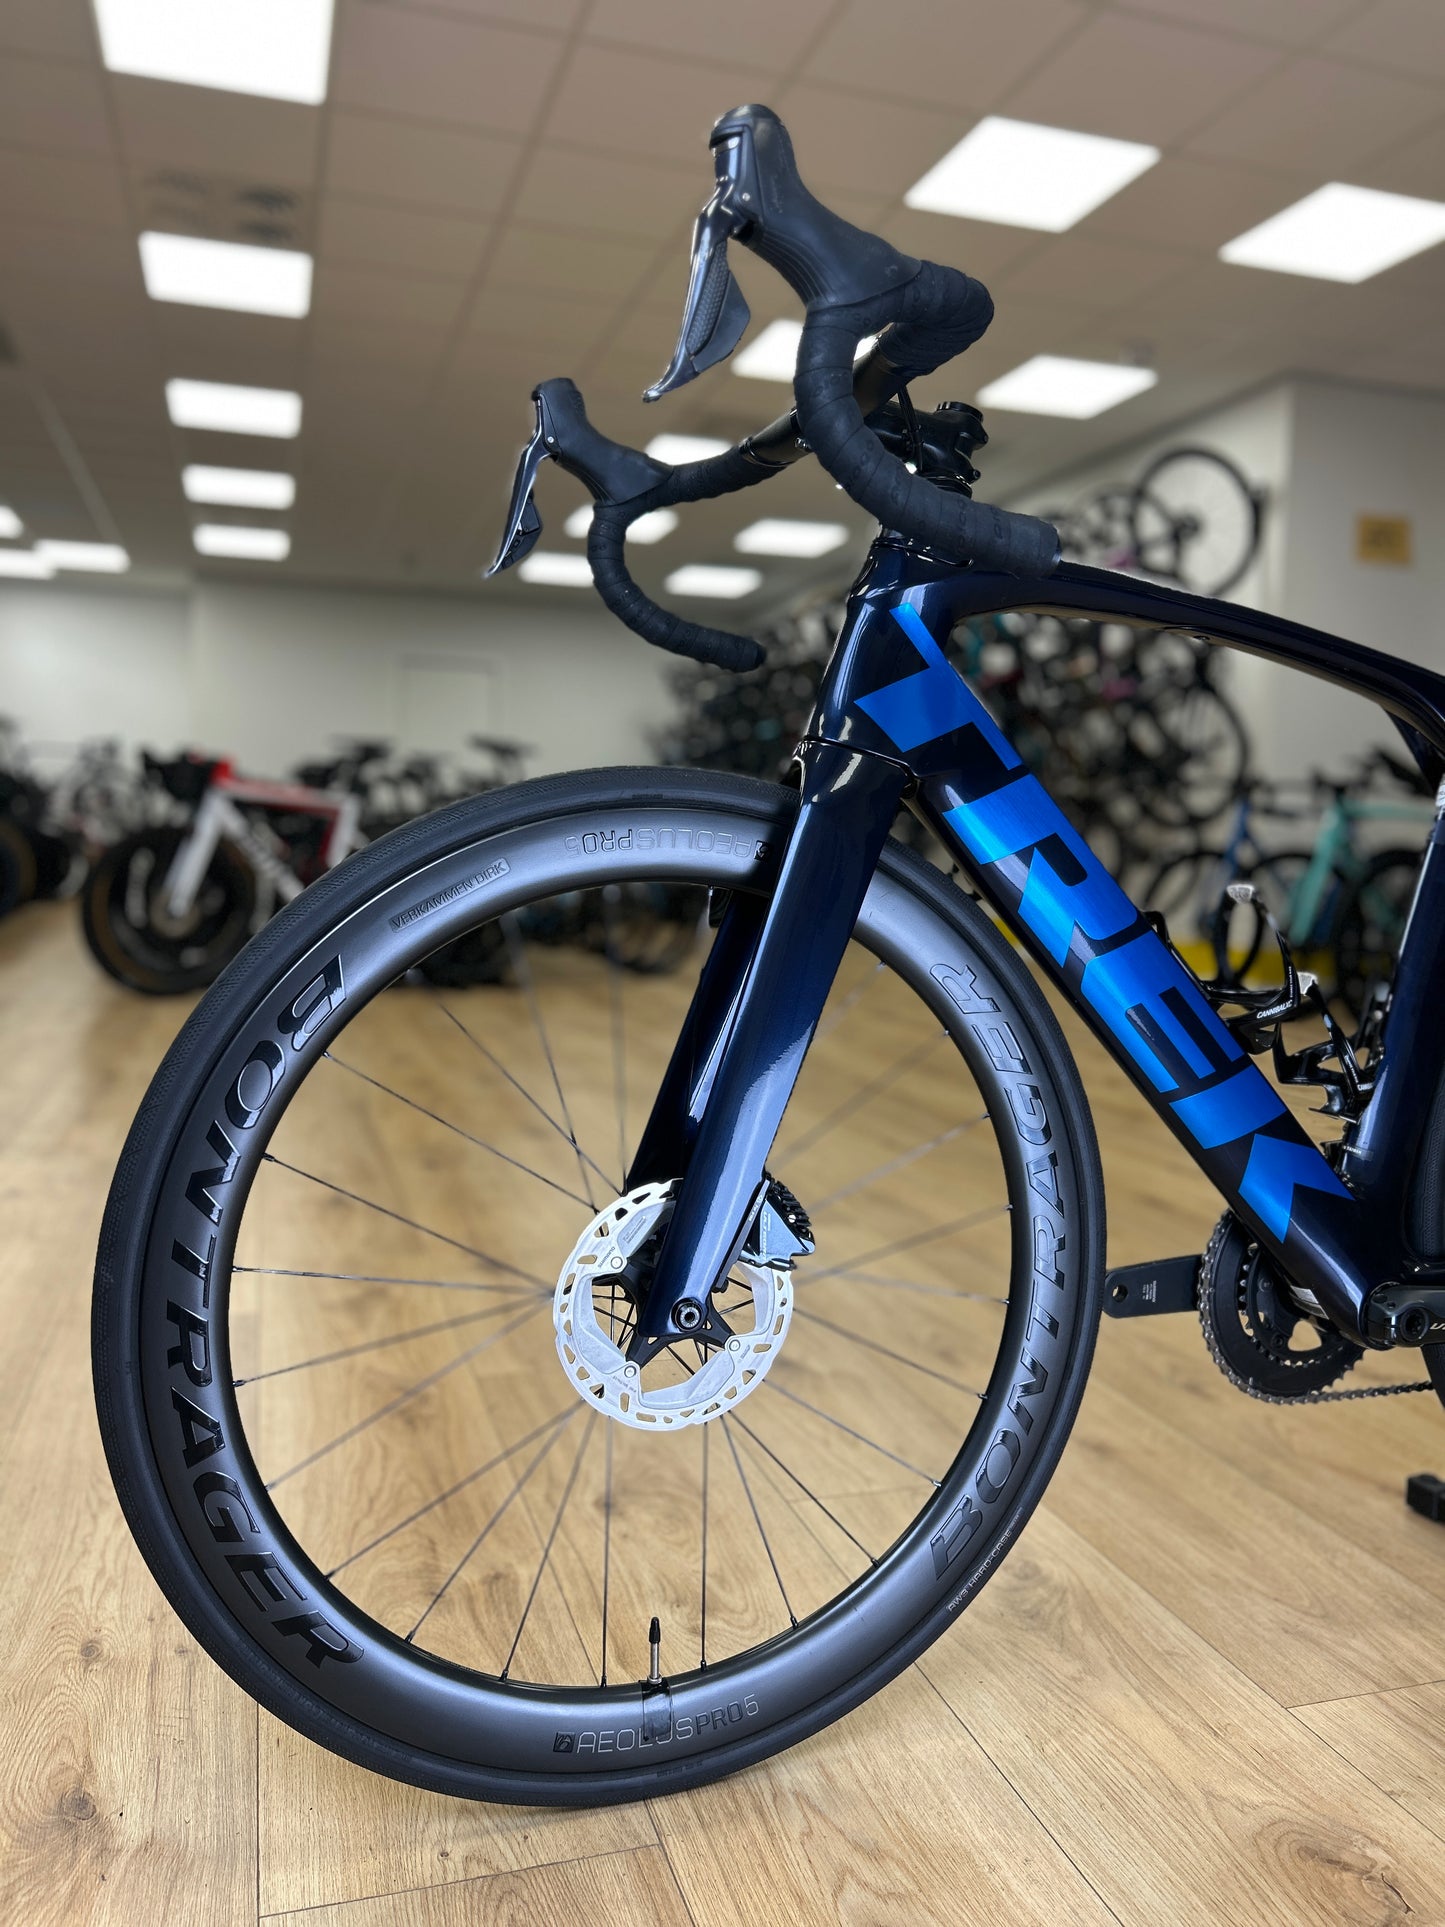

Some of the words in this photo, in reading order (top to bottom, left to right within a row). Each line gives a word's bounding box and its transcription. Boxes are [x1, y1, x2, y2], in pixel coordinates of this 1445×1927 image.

[392, 880, 473, 928] VERKAMMEN
[475, 861, 505, 884] DIRK
[854, 602, 1355, 1243] TREK
[166, 954, 364, 1669] BONTRAGER
[930, 962, 1066, 1581] BONTRAGER
